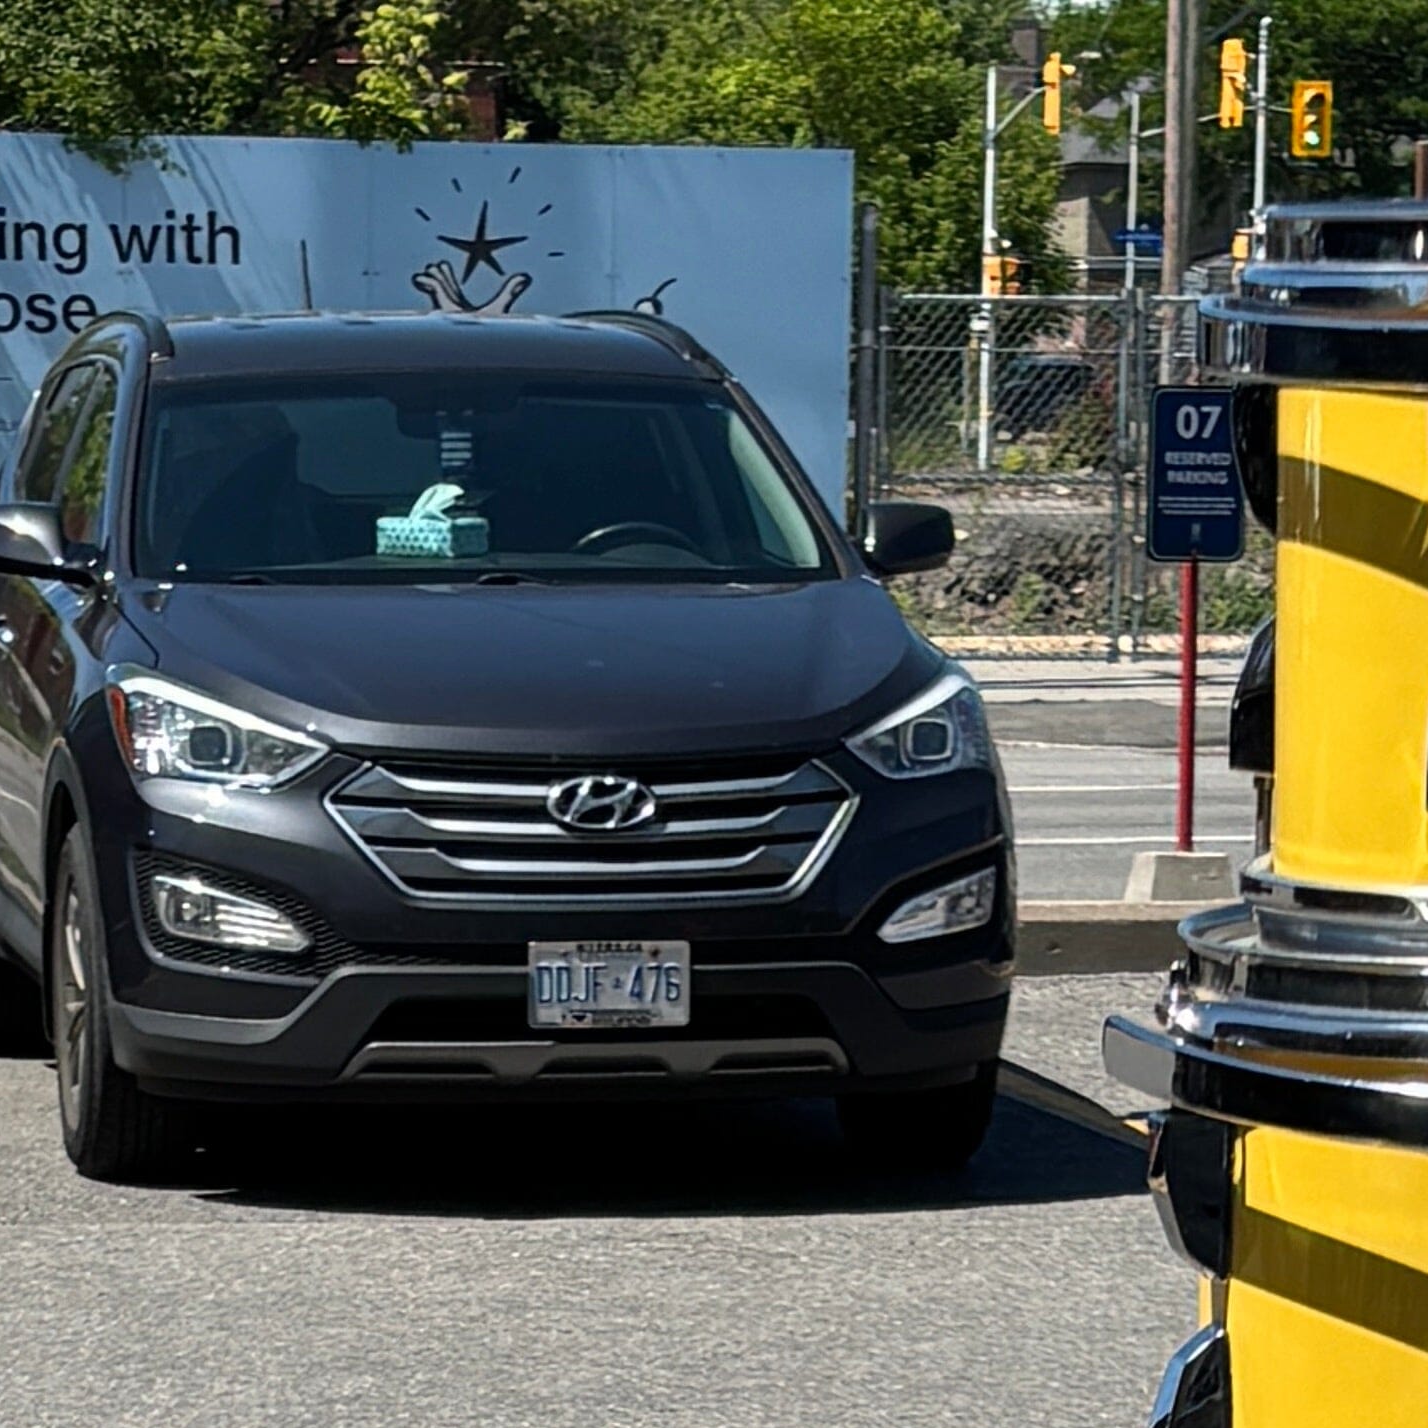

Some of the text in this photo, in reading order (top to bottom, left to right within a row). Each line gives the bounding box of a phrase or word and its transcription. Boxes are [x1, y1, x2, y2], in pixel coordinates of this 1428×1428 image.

[109, 209, 241, 265] with
[1176, 404, 1223, 440] 07
[1164, 451, 1232, 467] RESERVED
[1166, 470, 1229, 485] PARKING
